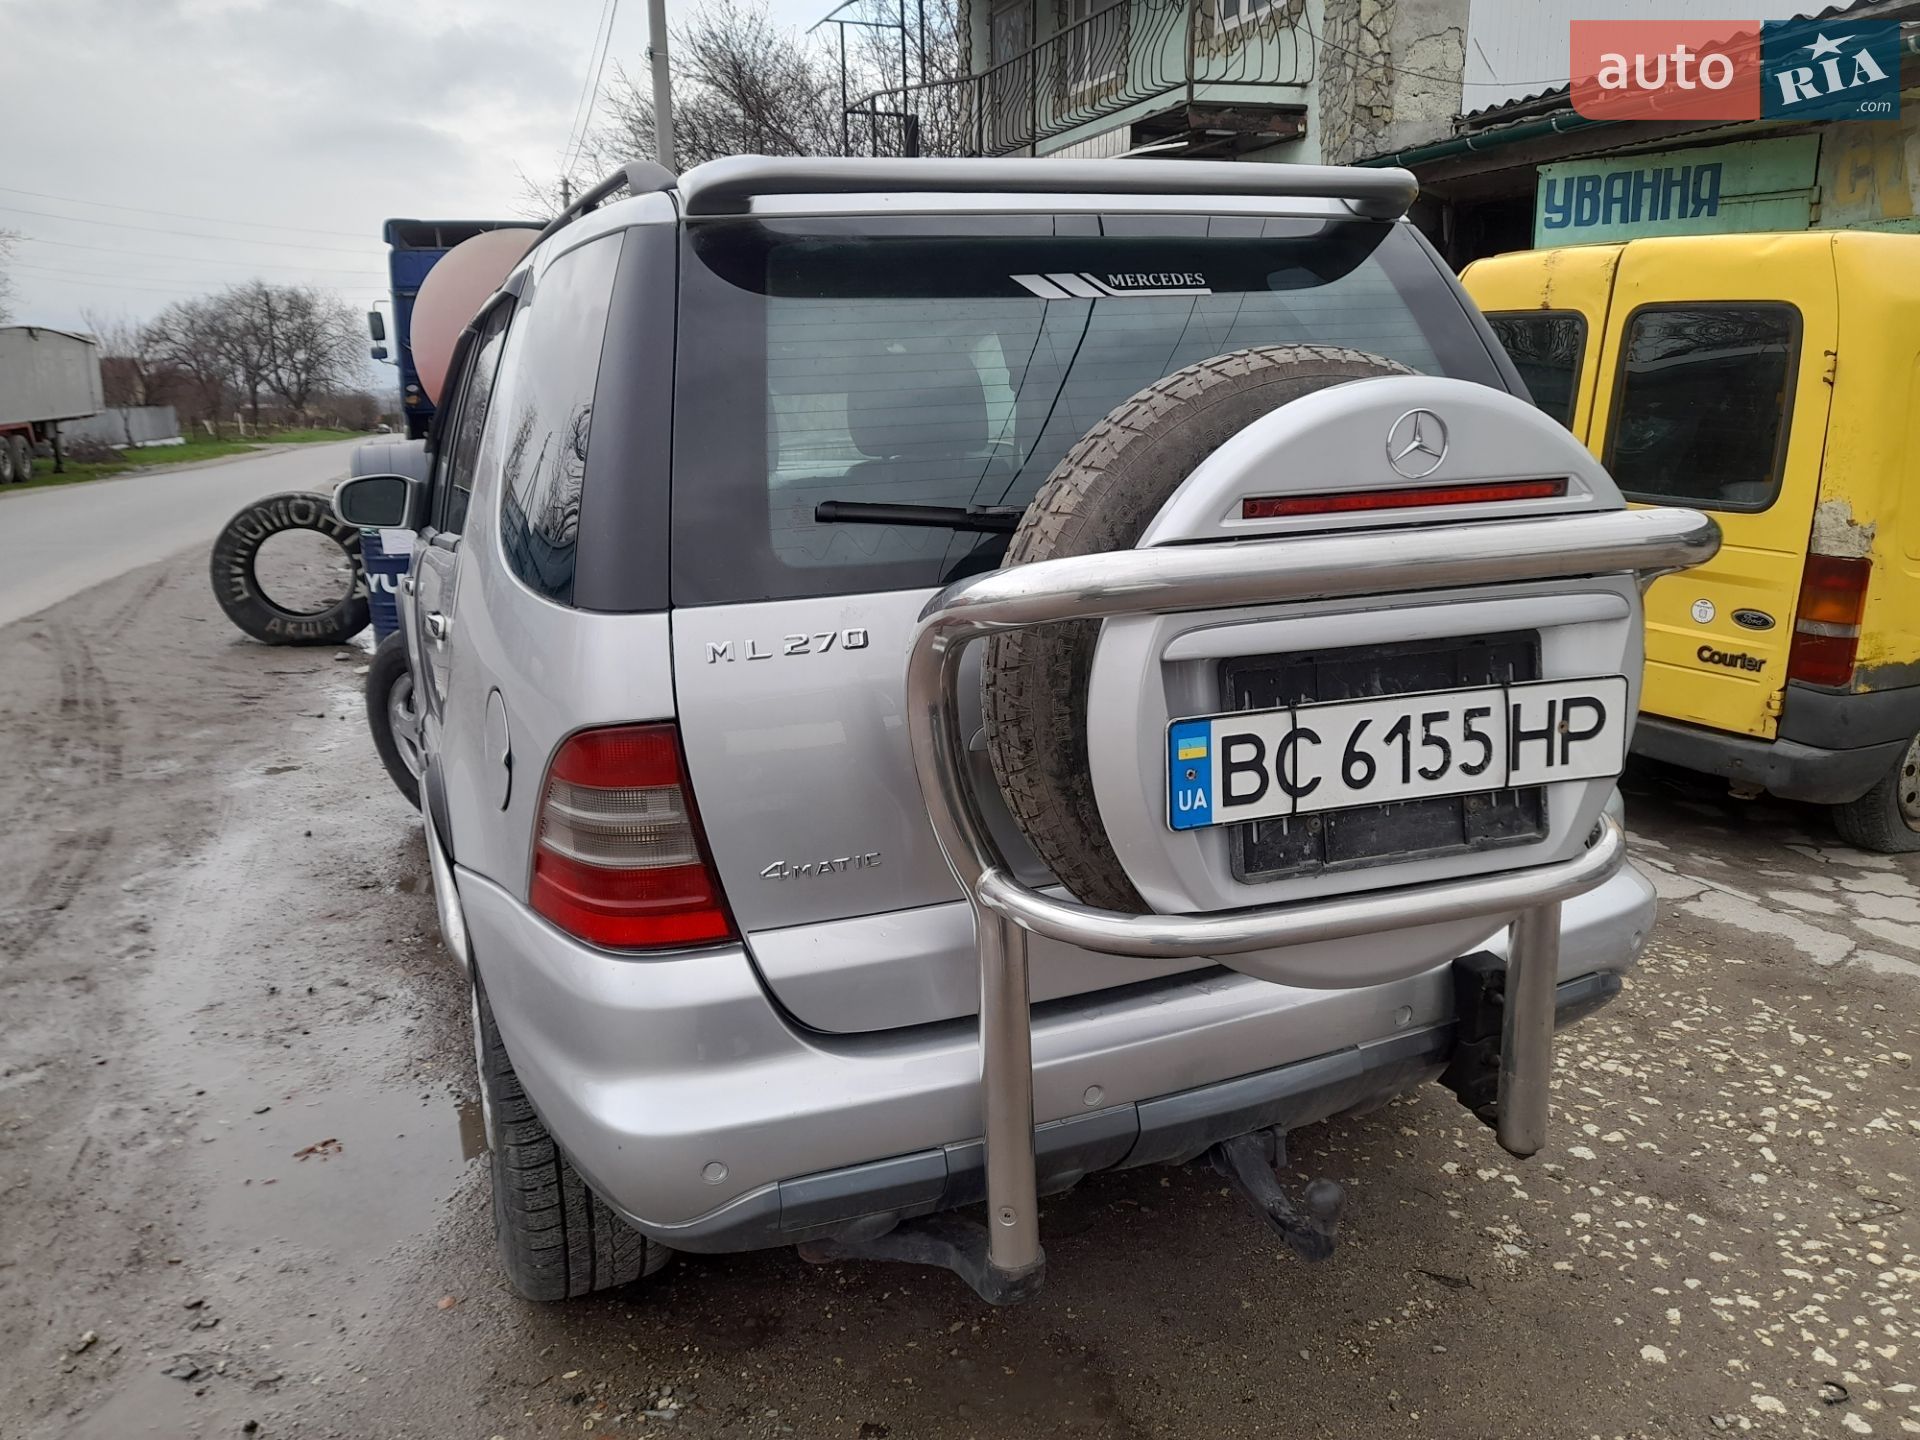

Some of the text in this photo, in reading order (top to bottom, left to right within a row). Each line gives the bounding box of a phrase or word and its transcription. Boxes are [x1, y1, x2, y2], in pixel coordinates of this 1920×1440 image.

[1544, 163, 1722, 229] УВАННЯ
[1107, 272, 1206, 287] MERCEDES
[265, 617, 339, 637] АКЦІЯ
[783, 627, 869, 656] 270
[1697, 645, 1766, 672] Courier
[1221, 696, 1606, 807] BC 6155 HP
[1178, 787, 1208, 811] UA
[759, 852, 881, 880] 4MATIC
